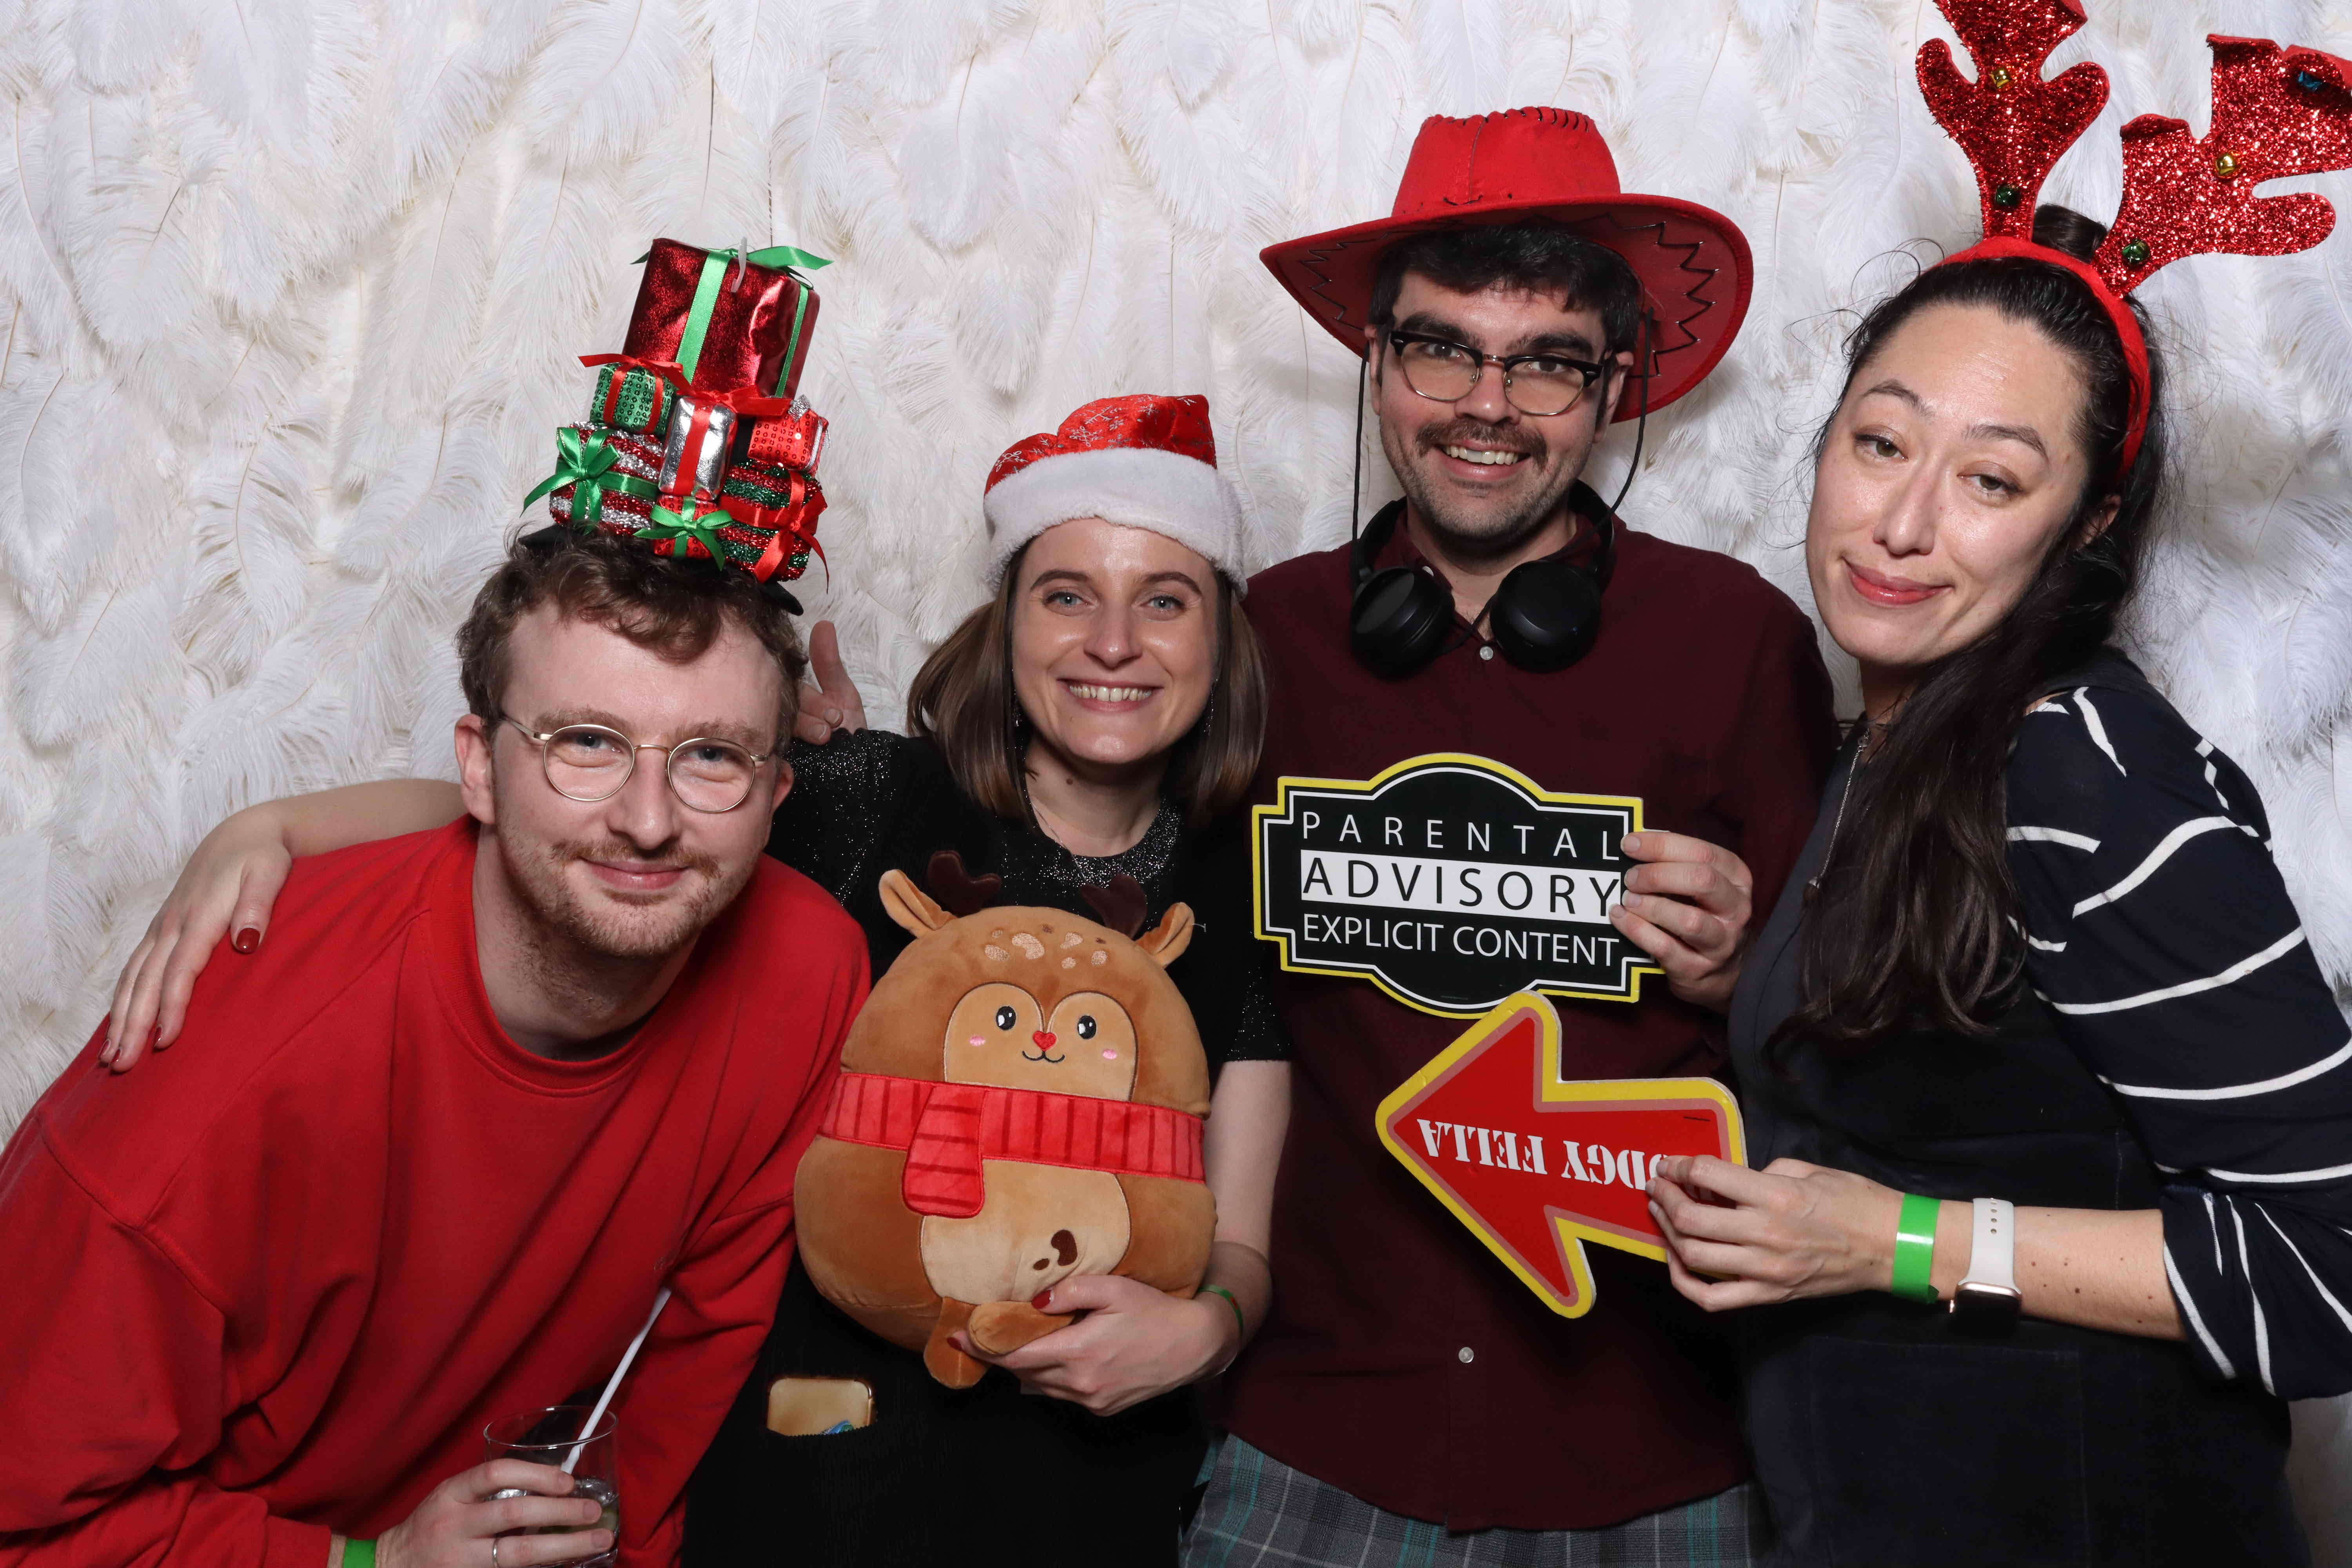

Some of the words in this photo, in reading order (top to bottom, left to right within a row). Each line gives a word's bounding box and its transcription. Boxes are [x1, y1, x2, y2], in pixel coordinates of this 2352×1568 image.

[1303, 812, 1619, 860] PARENTAL
[1303, 857, 1619, 916] ADVISORY
[1304, 914, 1444, 951] EXPLICIT
[1453, 927, 1620, 966] CONTENT
[1417, 1119, 1548, 1175] FELLA
[1561, 1141, 1714, 1201] DGY
